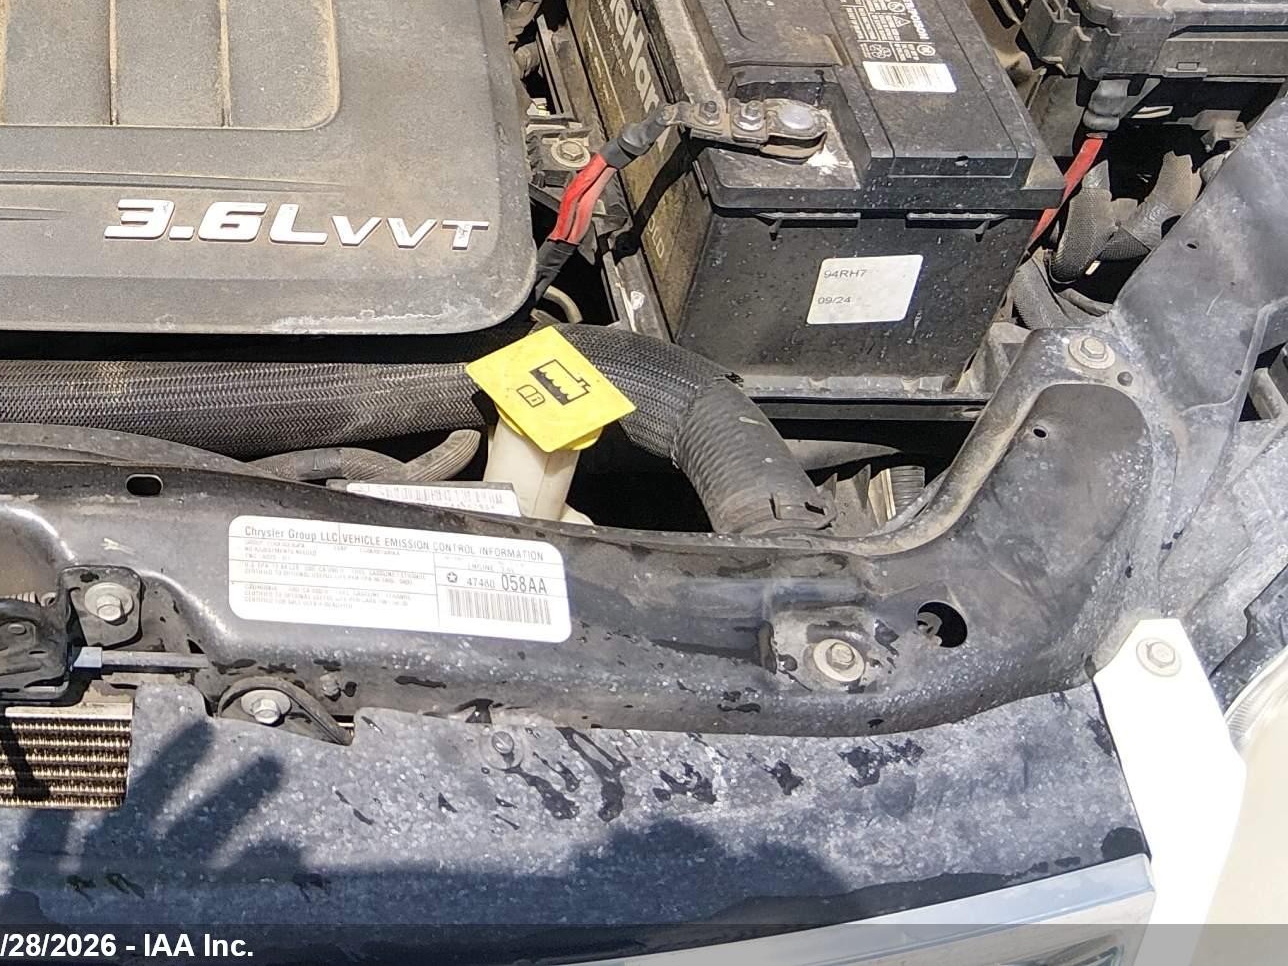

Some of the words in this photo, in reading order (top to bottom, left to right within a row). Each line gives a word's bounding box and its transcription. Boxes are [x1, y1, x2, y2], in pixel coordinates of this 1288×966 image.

[104, 198, 329, 245] 3.6L
[331, 215, 490, 250] VVT
[647, 215, 665, 260] OLD
[823, 269, 868, 279] 94RH7
[817, 296, 852, 305] 09/24
[244, 525, 285, 540] Chrysler
[288, 527, 317, 543] Group
[319, 530, 338, 542] LLC
[342, 532, 381, 547] VEHICLE
[384, 536, 430, 551] EMISSION
[432, 540, 476, 554] CONTROL
[479, 543, 544, 562] INFORMATION
[500, 573, 548, 594] 058AA
